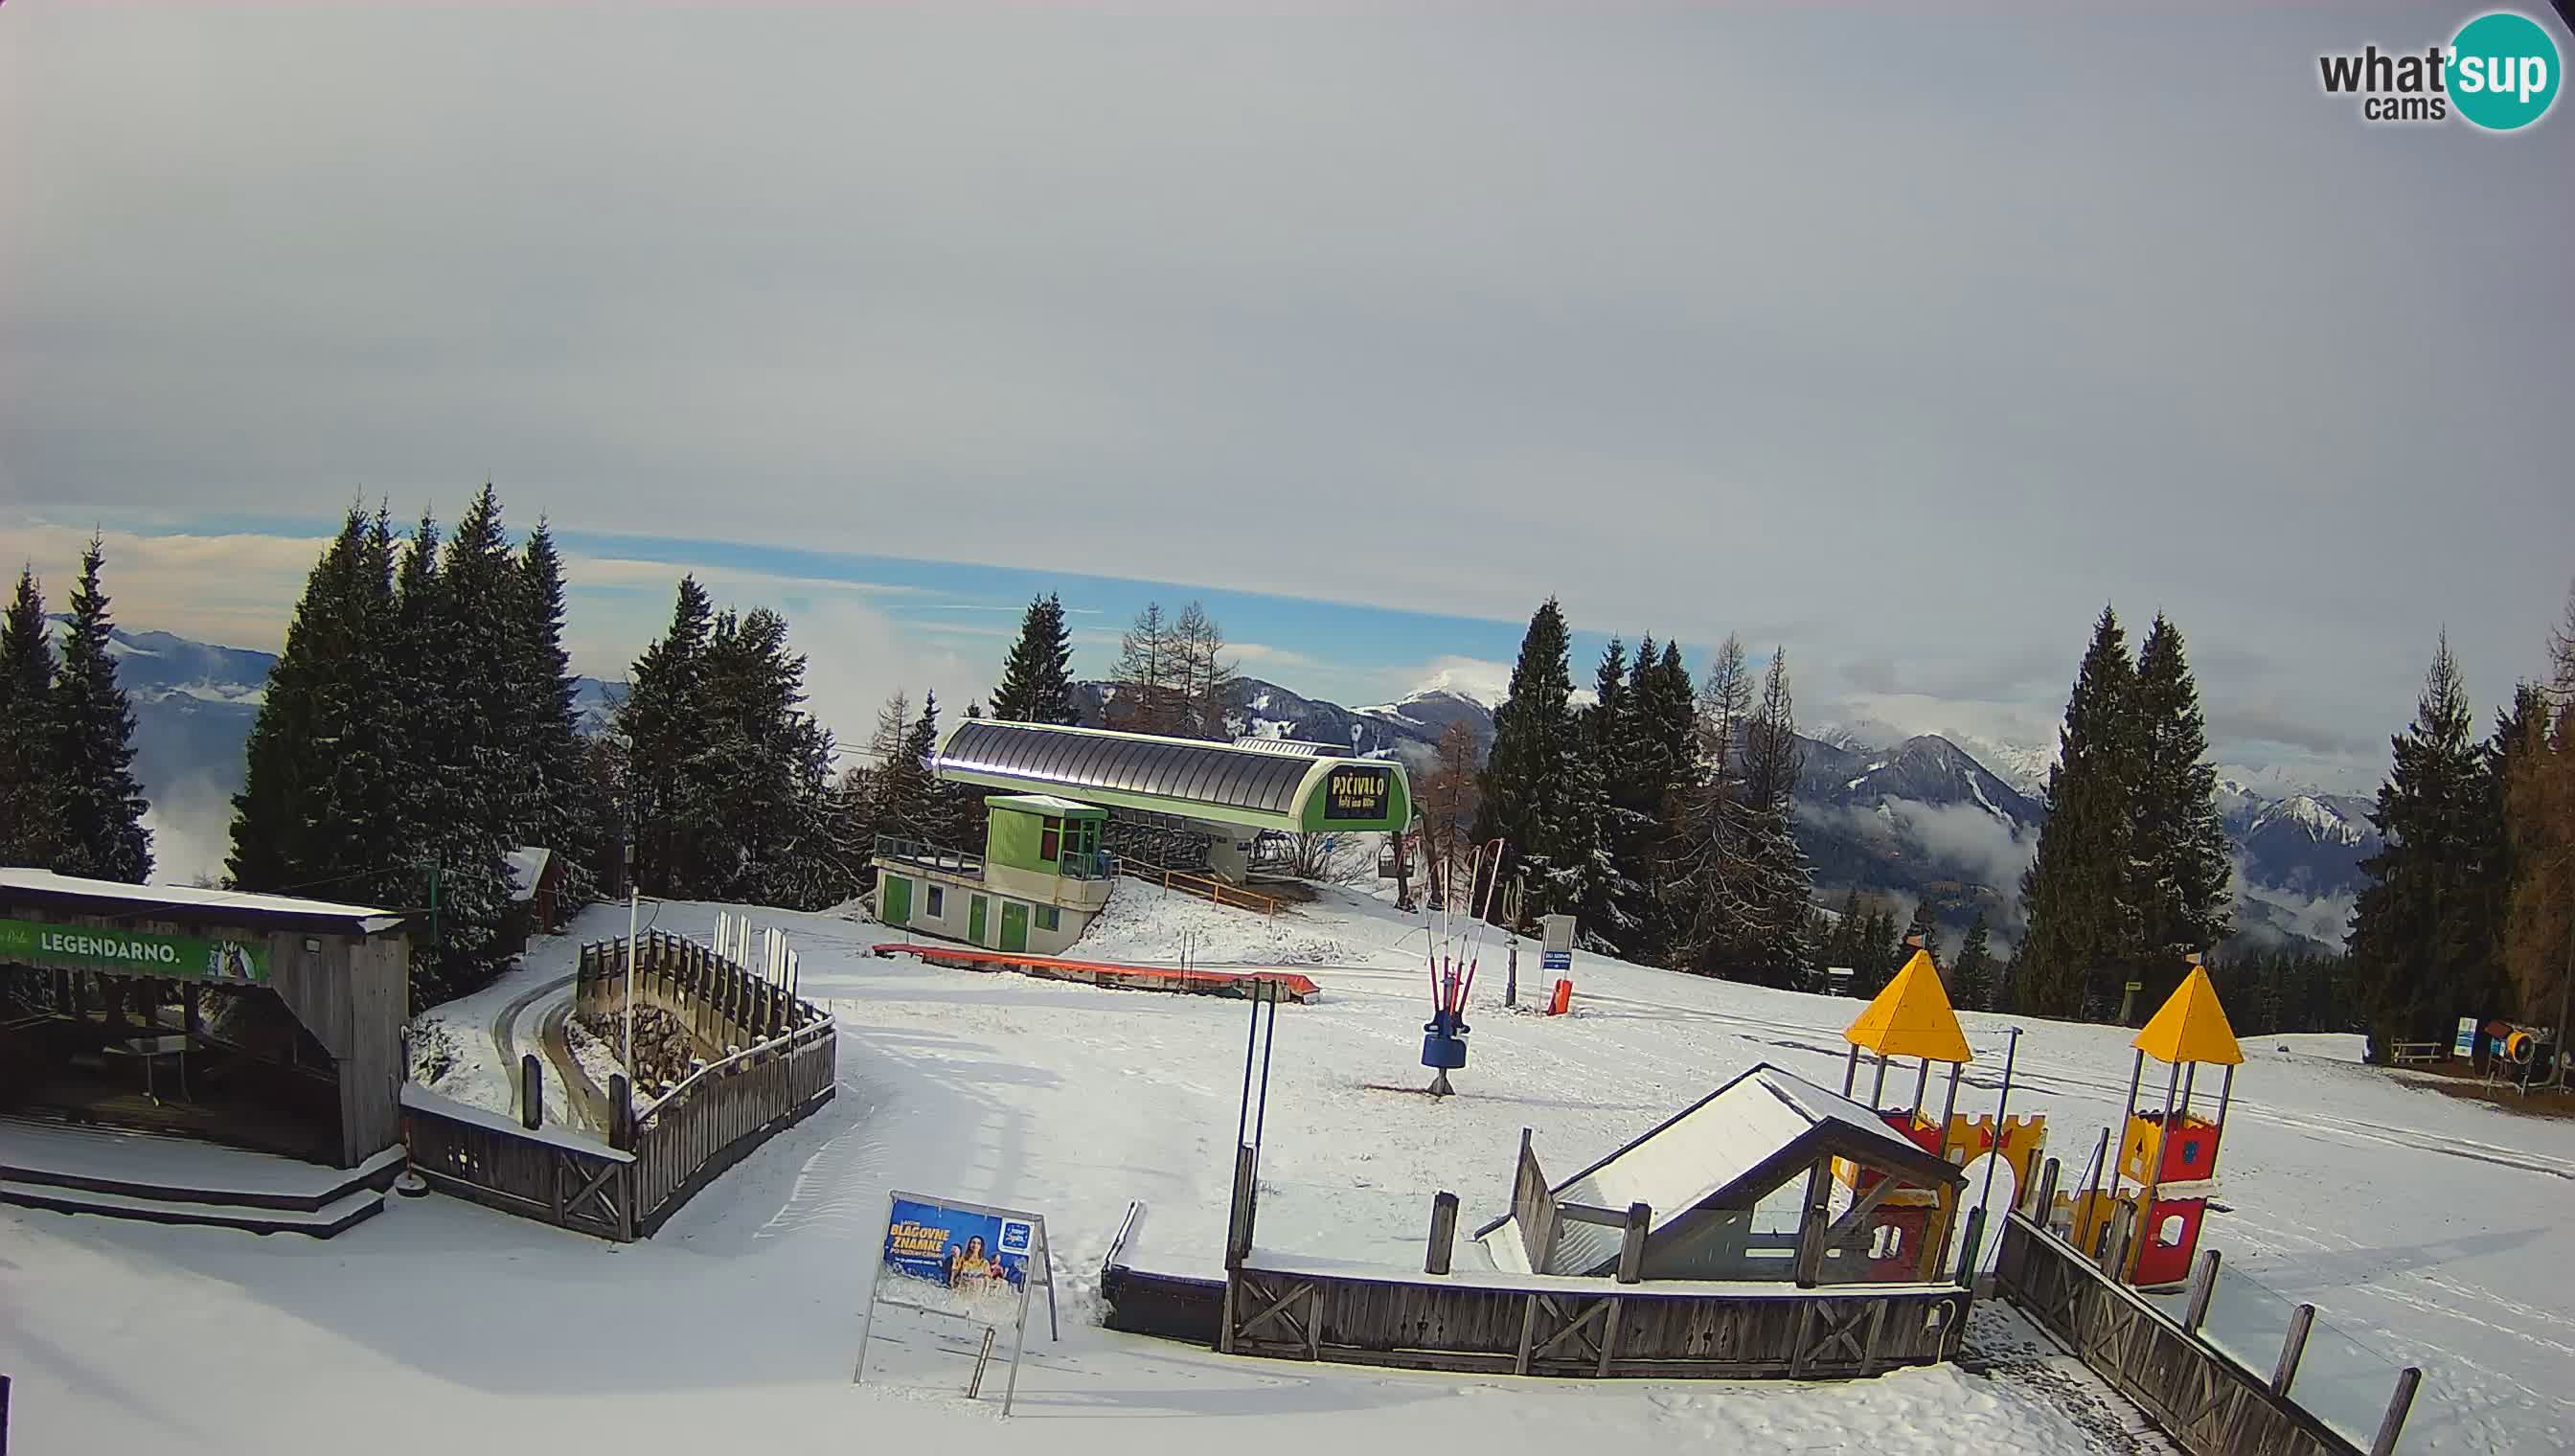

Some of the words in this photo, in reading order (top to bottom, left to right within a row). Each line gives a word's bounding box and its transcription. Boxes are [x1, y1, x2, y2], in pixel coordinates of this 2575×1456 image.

[41, 932, 181, 965] LEGENDARNO.
[890, 1223, 951, 1241] BLAGOVNE
[892, 1236, 944, 1252] ZNAMKE
